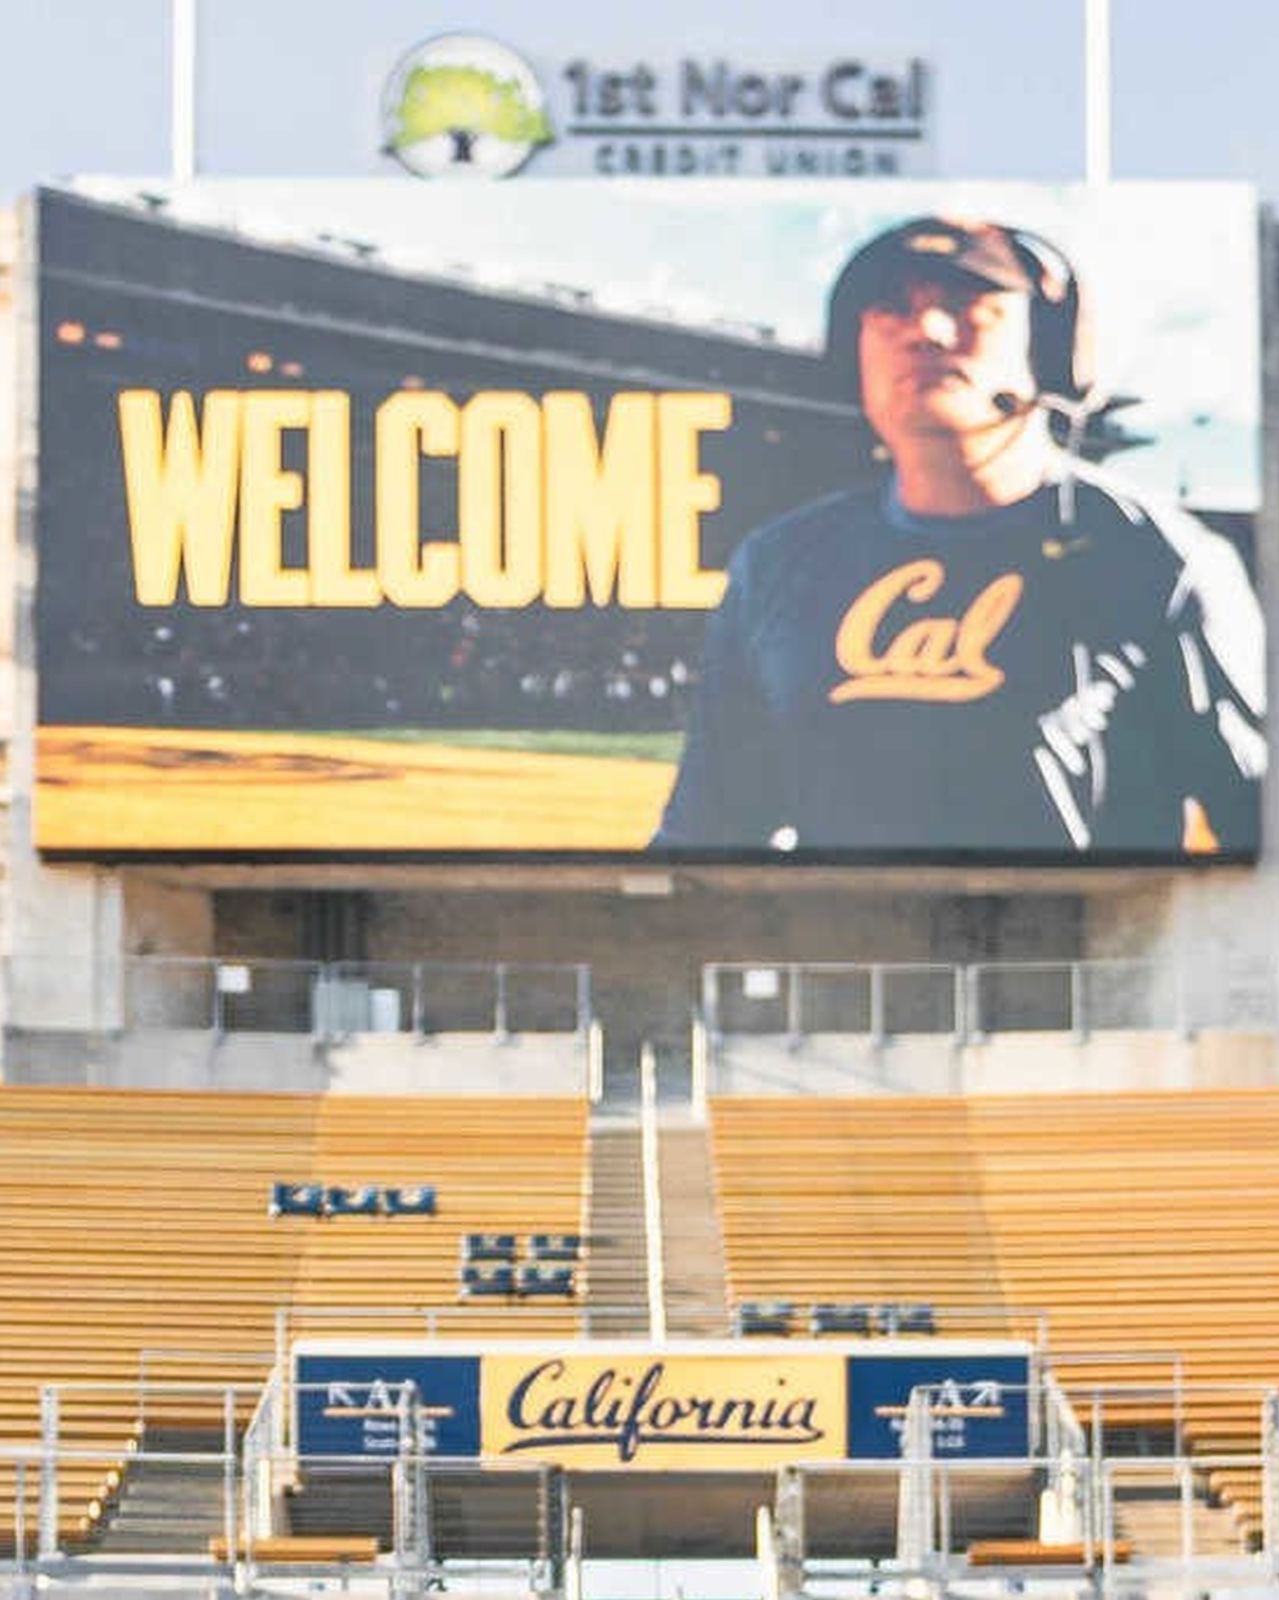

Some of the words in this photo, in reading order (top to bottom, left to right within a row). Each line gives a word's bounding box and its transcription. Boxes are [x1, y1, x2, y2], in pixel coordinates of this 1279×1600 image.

[562, 58, 658, 118] 1st
[680, 60, 805, 118] Nor
[820, 58, 929, 120] Cal
[594, 145, 741, 177] CREDIT
[765, 146, 900, 178] UNION
[119, 388, 732, 609] WELCOME
[828, 556, 1024, 705] Cal
[500, 1359, 825, 1463] California
